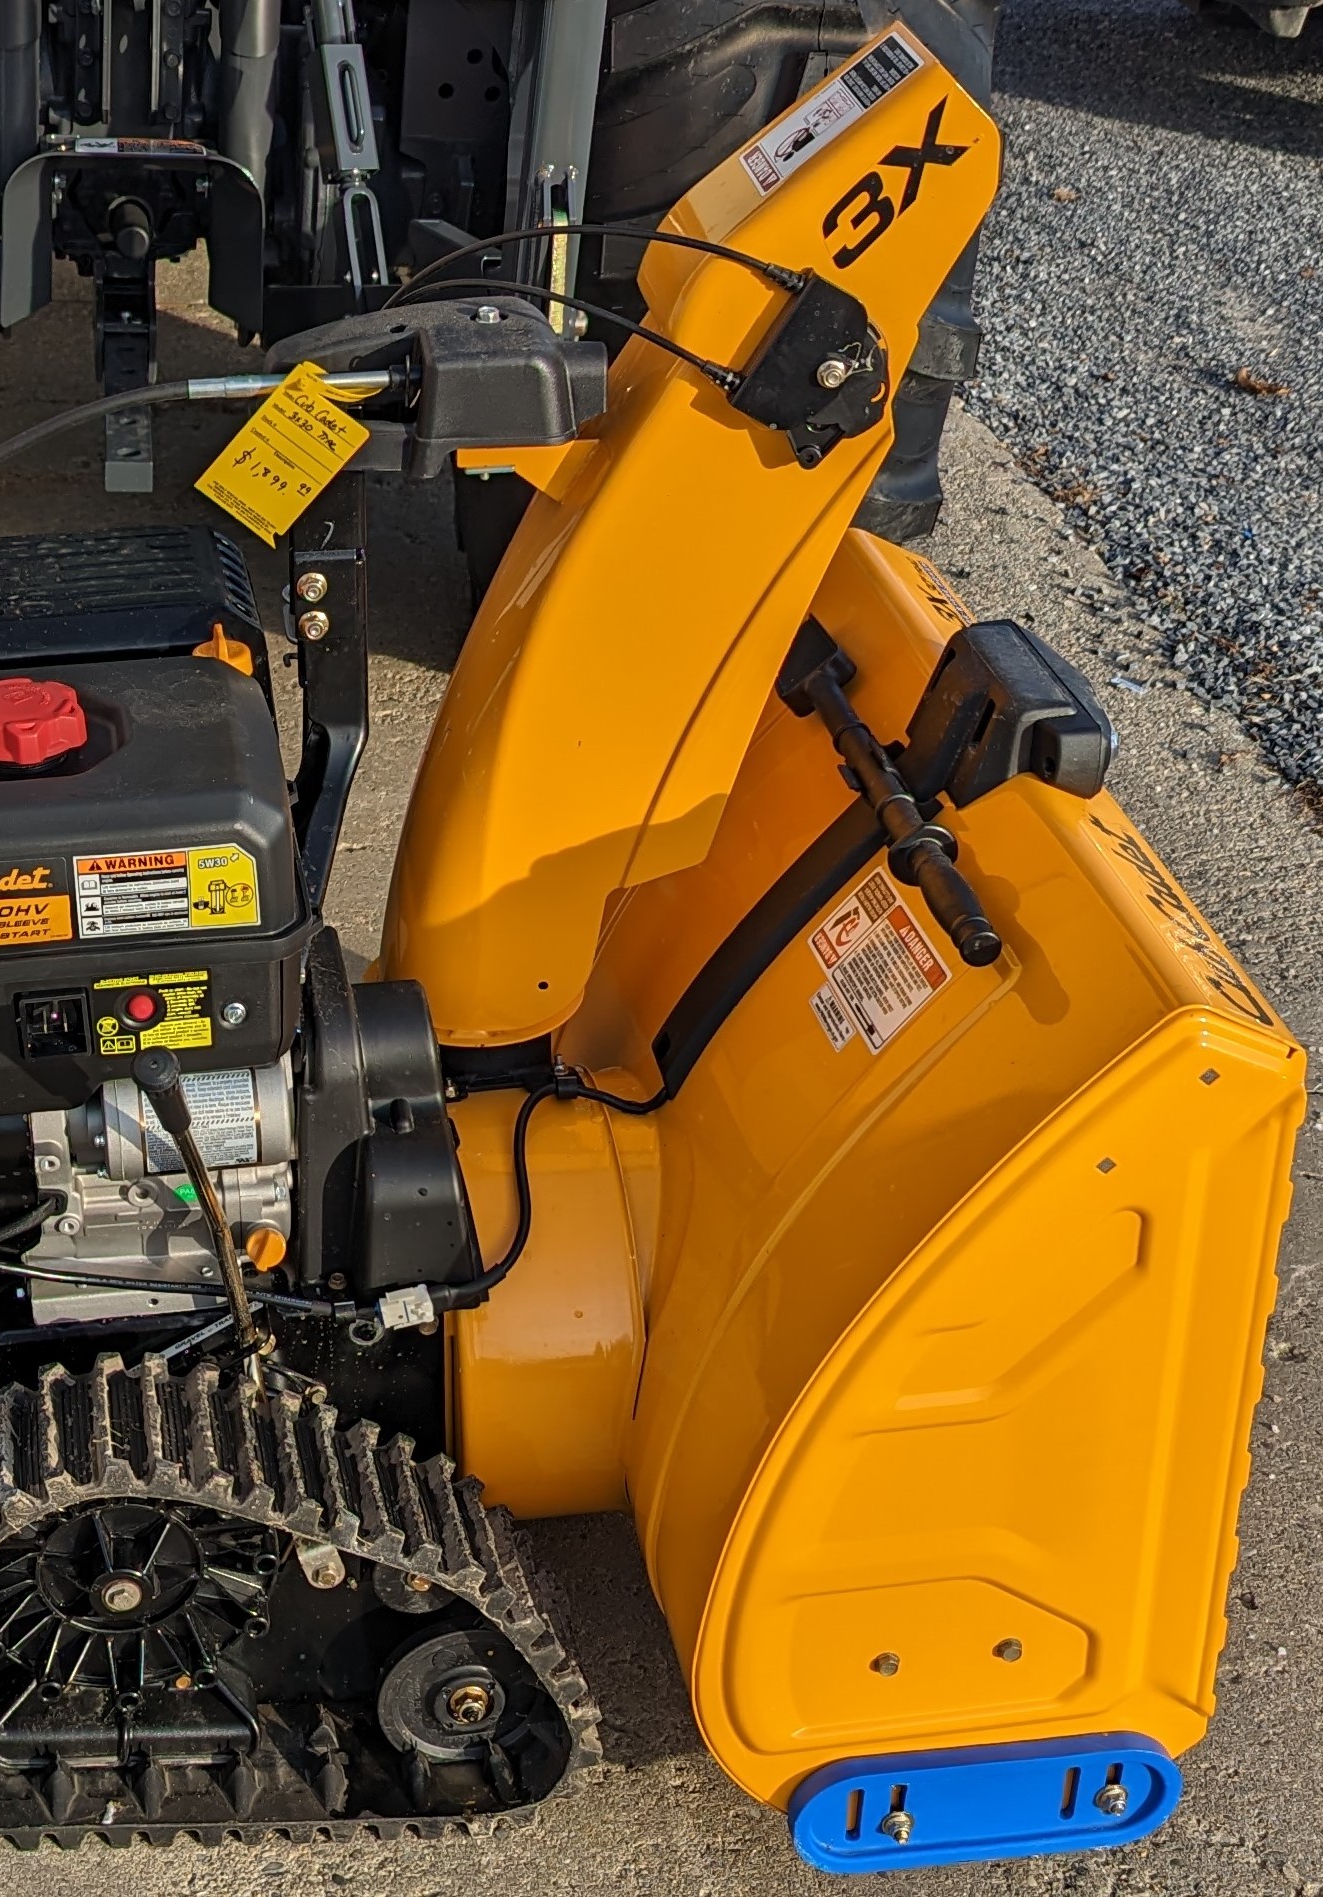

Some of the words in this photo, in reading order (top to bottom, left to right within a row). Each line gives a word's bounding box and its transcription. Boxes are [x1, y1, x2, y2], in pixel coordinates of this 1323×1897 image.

[747, 151, 774, 182] DANGER
[822, 93, 972, 270] 3X
[295, 394, 315, 413] Cub
[315, 410, 347, 434] Cadet
[105, 854, 175, 870] WARNING
[197, 855, 228, 869] 5W30
[1088, 812, 1211, 943] Cadet
[0, 928, 52, 940] START
[904, 930, 935, 973] DANGER
